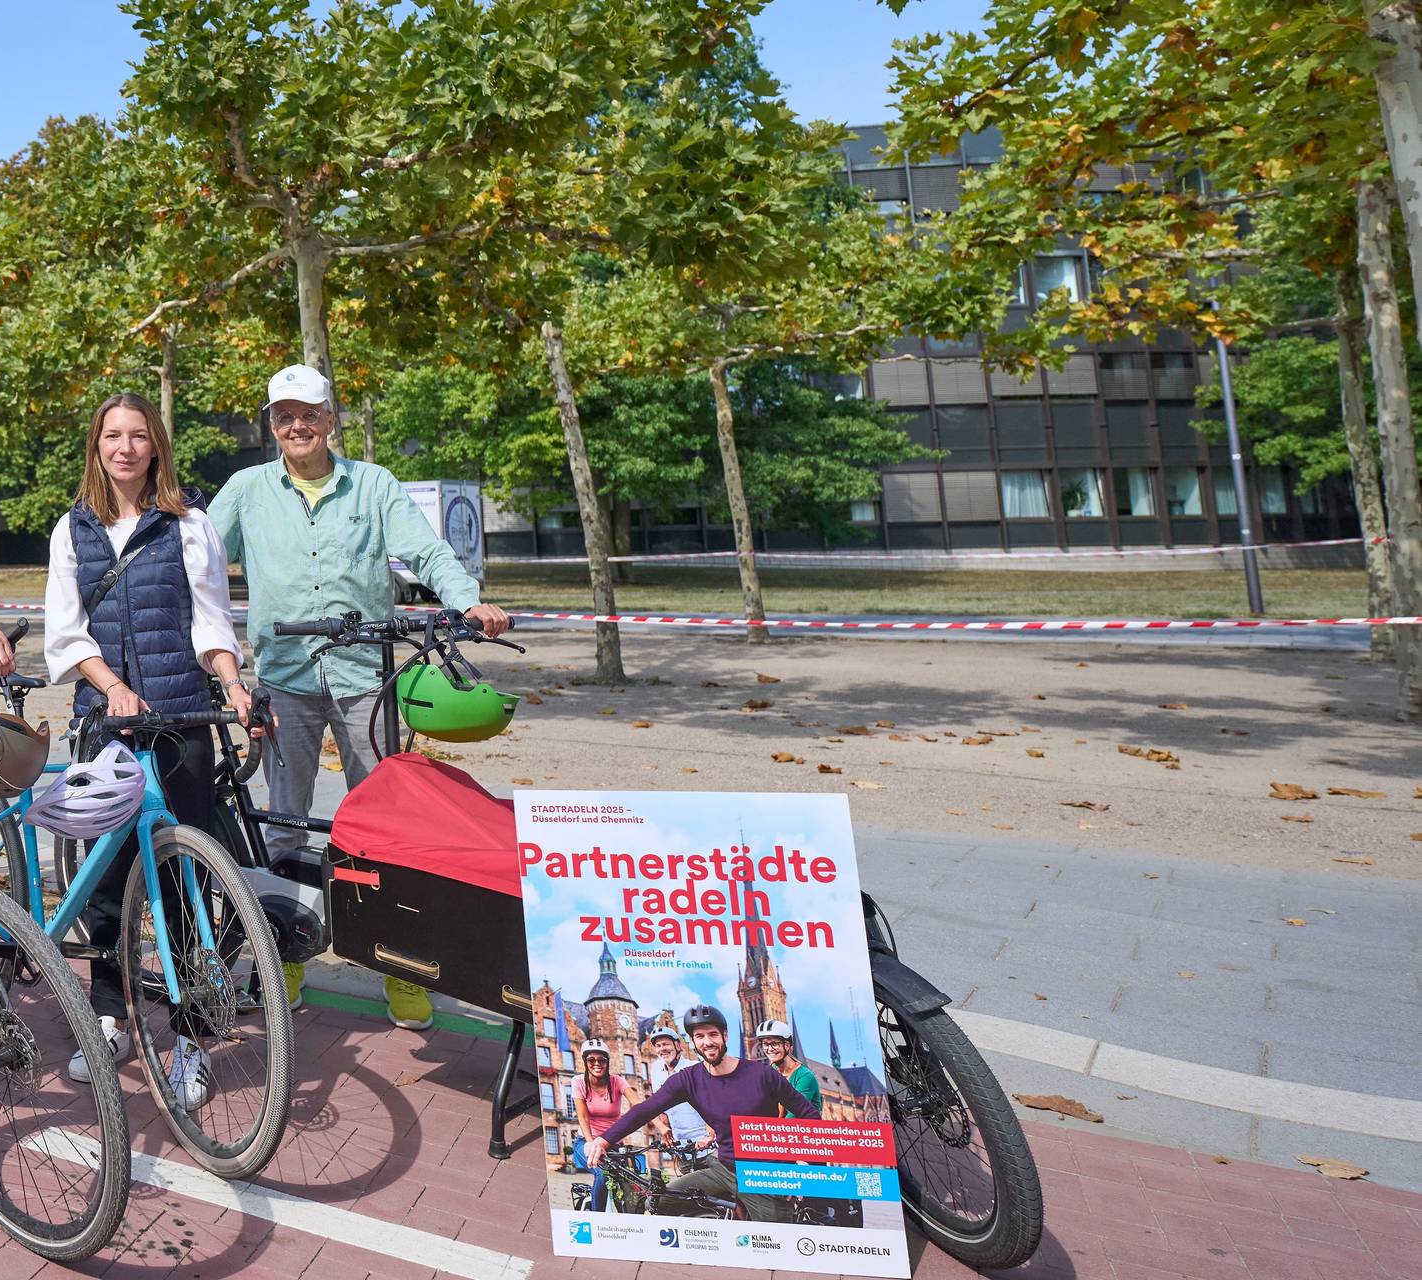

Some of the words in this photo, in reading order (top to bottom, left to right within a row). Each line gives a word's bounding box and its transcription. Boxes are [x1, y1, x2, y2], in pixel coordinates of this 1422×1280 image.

[531, 805, 598, 813] STADTRADELN
[600, 806, 624, 814] 2025
[532, 815, 579, 823] Düsseldorf
[582, 815, 599, 823] und
[600, 815, 644, 824] Chemnitz
[518, 842, 837, 884] Partnerstädte
[622, 879, 771, 917] radeln
[580, 916, 835, 948] zusammen
[624, 949, 675, 958] Düsseldorf
[625, 958, 651, 967] Nähe
[652, 959, 674, 968] trifft
[676, 960, 713, 969] Freiheit
[739, 1122, 763, 1131] Jetzt
[765, 1123, 811, 1133] kostenlos
[813, 1126, 861, 1136] anmelden
[862, 1128, 881, 1137] und
[740, 1133, 760, 1142] vom
[763, 1134, 770, 1142] 1.
[772, 1134, 786, 1143] bis
[788, 1135, 801, 1143] 21.
[803, 1136, 857, 1147] September
[859, 1139, 884, 1148] 2025
[741, 1143, 788, 1154] Kilometer
[790, 1146, 834, 1156] sammeln
[743, 1168, 847, 1182] www.stadtradeln.de/
[745, 1179, 802, 1190] duesseldorf
[597, 1225, 644, 1235] Landeshauptstadt
[684, 1229, 718, 1238] CHEMNITZ
[598, 1232, 627, 1240] Düsseldorf
[751, 1234, 772, 1242] KLIMA
[752, 1241, 781, 1250] BÜNDNIS
[819, 1244, 891, 1256] STADTRADELN
